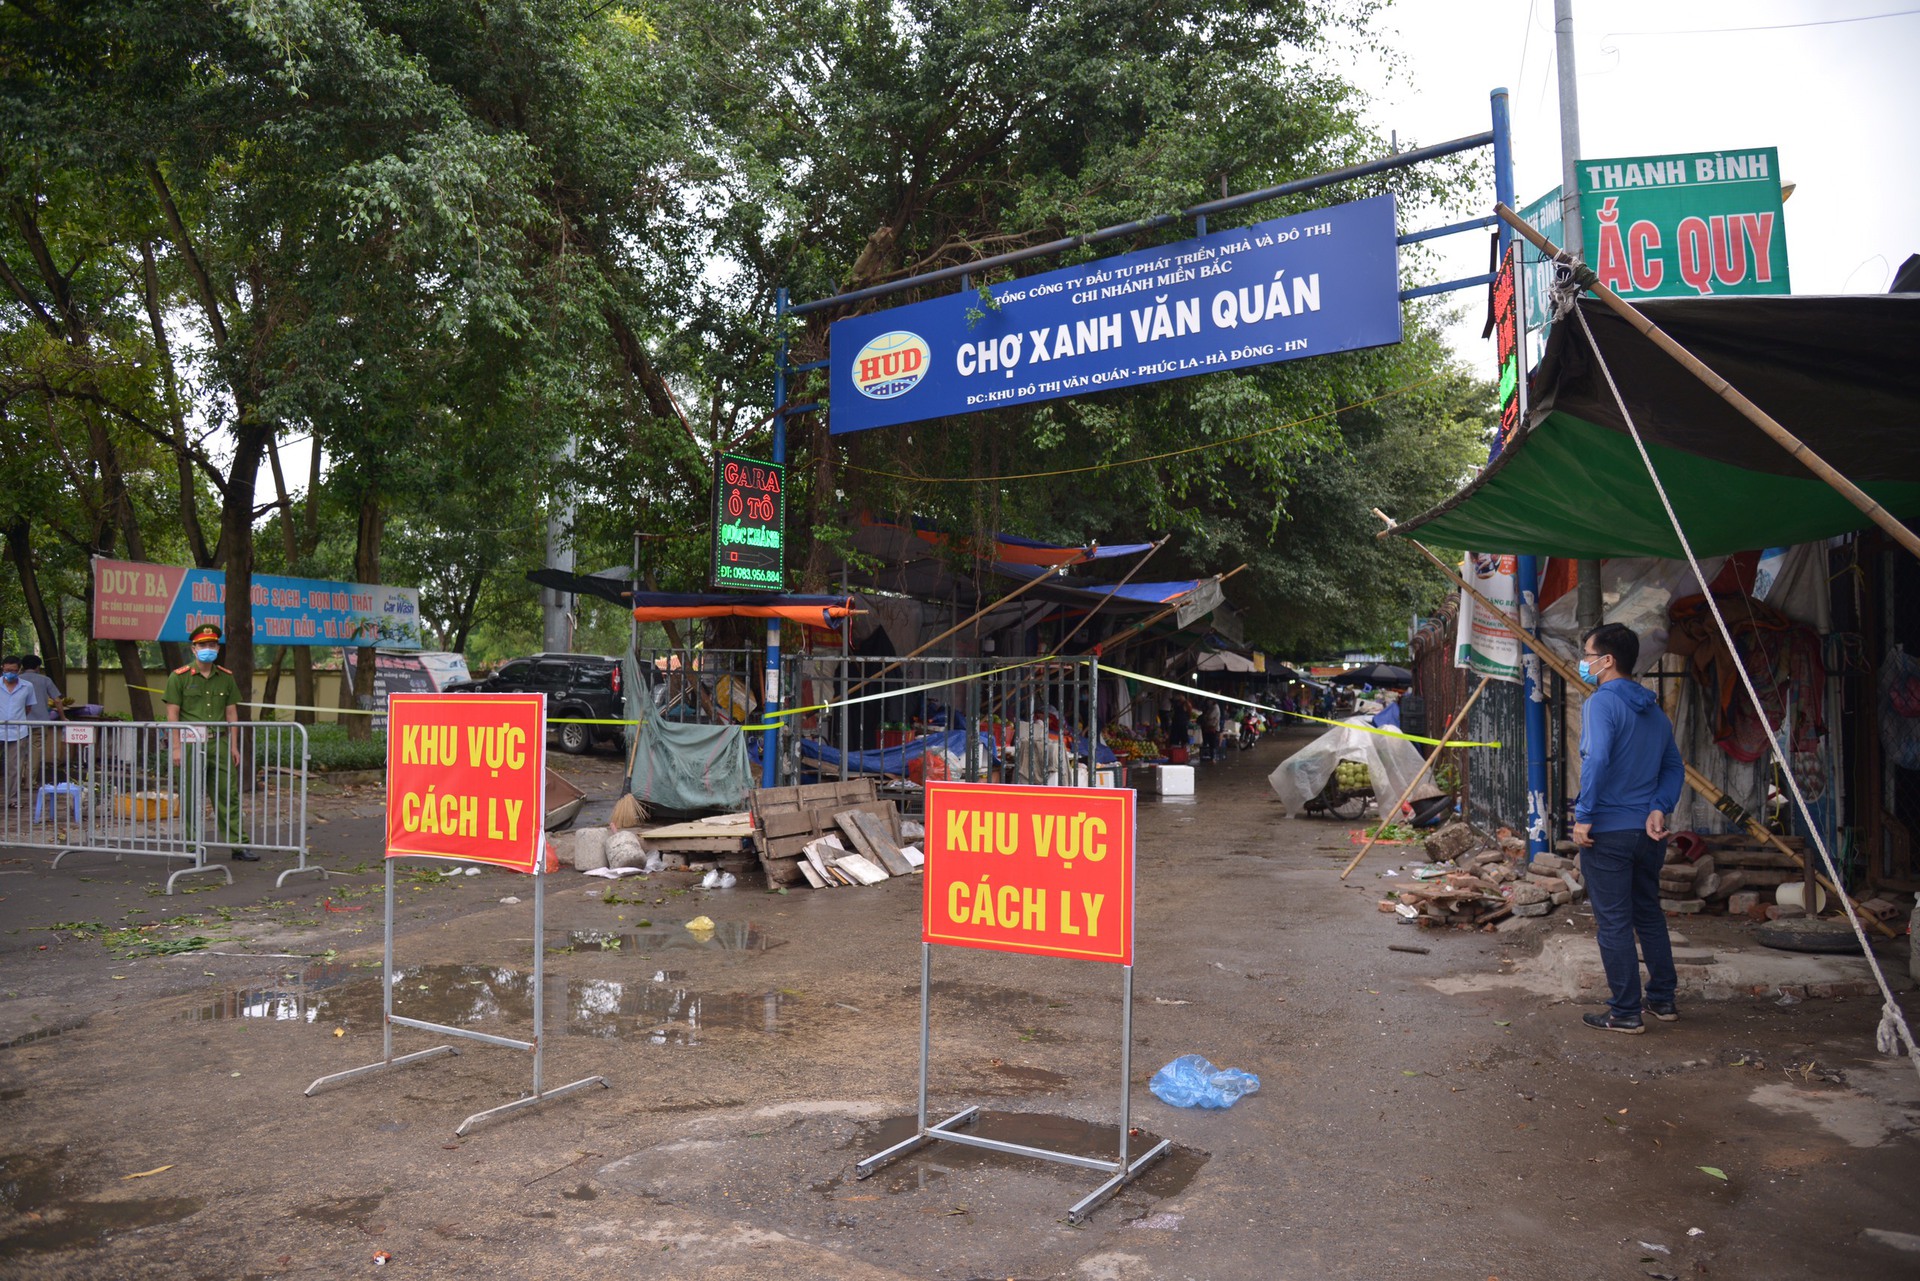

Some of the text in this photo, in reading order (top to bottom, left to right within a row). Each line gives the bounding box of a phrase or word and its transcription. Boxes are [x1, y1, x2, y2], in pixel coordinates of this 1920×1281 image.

[1586, 153, 1769, 189] THANH BÌNH
[1029, 283, 1063, 297] CÔNG
[1066, 278, 1083, 290] TY
[1085, 270, 1112, 286] ĐẦU
[1115, 265, 1134, 279] TƯ
[1135, 257, 1171, 275] PHÁT
[1174, 247, 1216, 266] TRIỂN
[1220, 238, 1251, 256] NHÀ
[1255, 233, 1274, 248] VÀ
[1277, 228, 1300, 245] ĐÔ
[1304, 222, 1332, 236] THỊ
[1596, 196, 1775, 295] ẮC QUY
[1072, 257, 1232, 305] CHI NHÁNH MIỀN BẮC
[956, 269, 1321, 378] CHỢ XANH VĂN QUÁN
[859, 347, 922, 383] HUD
[1018, 383, 1036, 397] ĐÔ
[1038, 380, 1060, 393] THỊ
[1063, 375, 1089, 389] VĂN
[1091, 366, 1129, 384] QUÁN
[1138, 360, 1177, 376] PHÚC
[1231, 345, 1274, 361] ĐÔNG
[1285, 338, 1308, 352] HN
[724, 462, 781, 493] GARA
[728, 488, 774, 521] Ô TÔ
[102, 568, 169, 598] DUY BA
[720, 565, 780, 583] ĐT: 0983.956.884
[192, 577, 217, 602] RỬA
[271, 588, 300, 611] SẠCH
[309, 591, 331, 613] DỌN
[332, 590, 350, 614] NỘI
[352, 591, 373, 612] THẤT
[384, 601, 414, 614] Car Wash
[264, 618, 292, 636] THAY
[324, 617, 338, 638] VÁ
[71, 733, 88, 741] STOP
[402, 722, 526, 778] KHU VỰC
[402, 784, 523, 842] CÁCH LY
[946, 809, 1107, 869] KHU VỰC
[948, 874, 1105, 937] CÁCH LY
